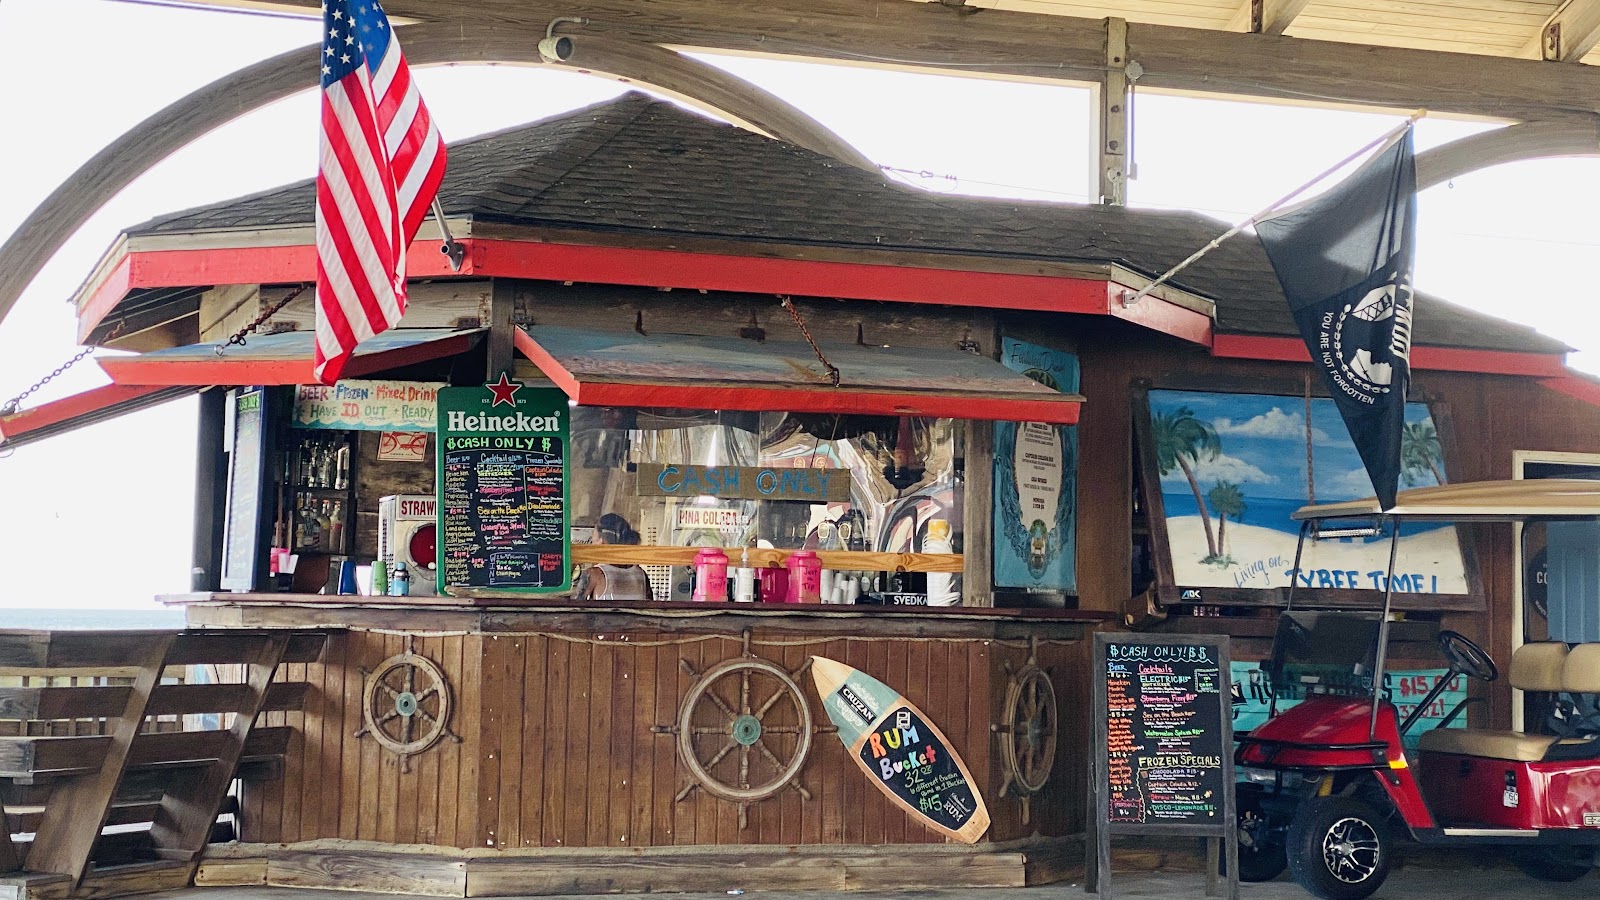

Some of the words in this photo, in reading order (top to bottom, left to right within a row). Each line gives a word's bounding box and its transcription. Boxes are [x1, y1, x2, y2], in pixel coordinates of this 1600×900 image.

[1322, 312, 1334, 329] YOU
[1320, 332, 1330, 349] ARE
[1322, 351, 1335, 368] NOT
[300, 385, 329, 401] BEER
[376, 385, 406, 400] Mixed
[408, 387, 436, 402] Drink
[1330, 371, 1374, 405] FORGOTTEN
[310, 404, 337, 418] HAVE
[340, 402, 360, 418] ID
[364, 406, 387, 417] OUT
[401, 405, 435, 420] READY
[447, 411, 560, 432] Heineken
[494, 438, 534, 450] ONLY
[657, 466, 740, 496] CASH
[755, 469, 833, 498] ONLY
[401, 500, 436, 516] STRAW
[679, 510, 700, 525] PINA
[1234, 559, 1270, 588] Living
[1120, 646, 1148, 658] CASH
[1107, 662, 1127, 671] BEER
[1140, 676, 1178, 684] ELECTRIC
[1400, 674, 1460, 697] $150
[842, 688, 874, 720] CRUZAN
[869, 725, 920, 759] RUM
[1138, 756, 1179, 768] FROZEN
[1180, 755, 1221, 766] SPECIALS
[904, 768, 924, 788] 32
[919, 793, 943, 813] $15
[943, 800, 964, 822] RUM
